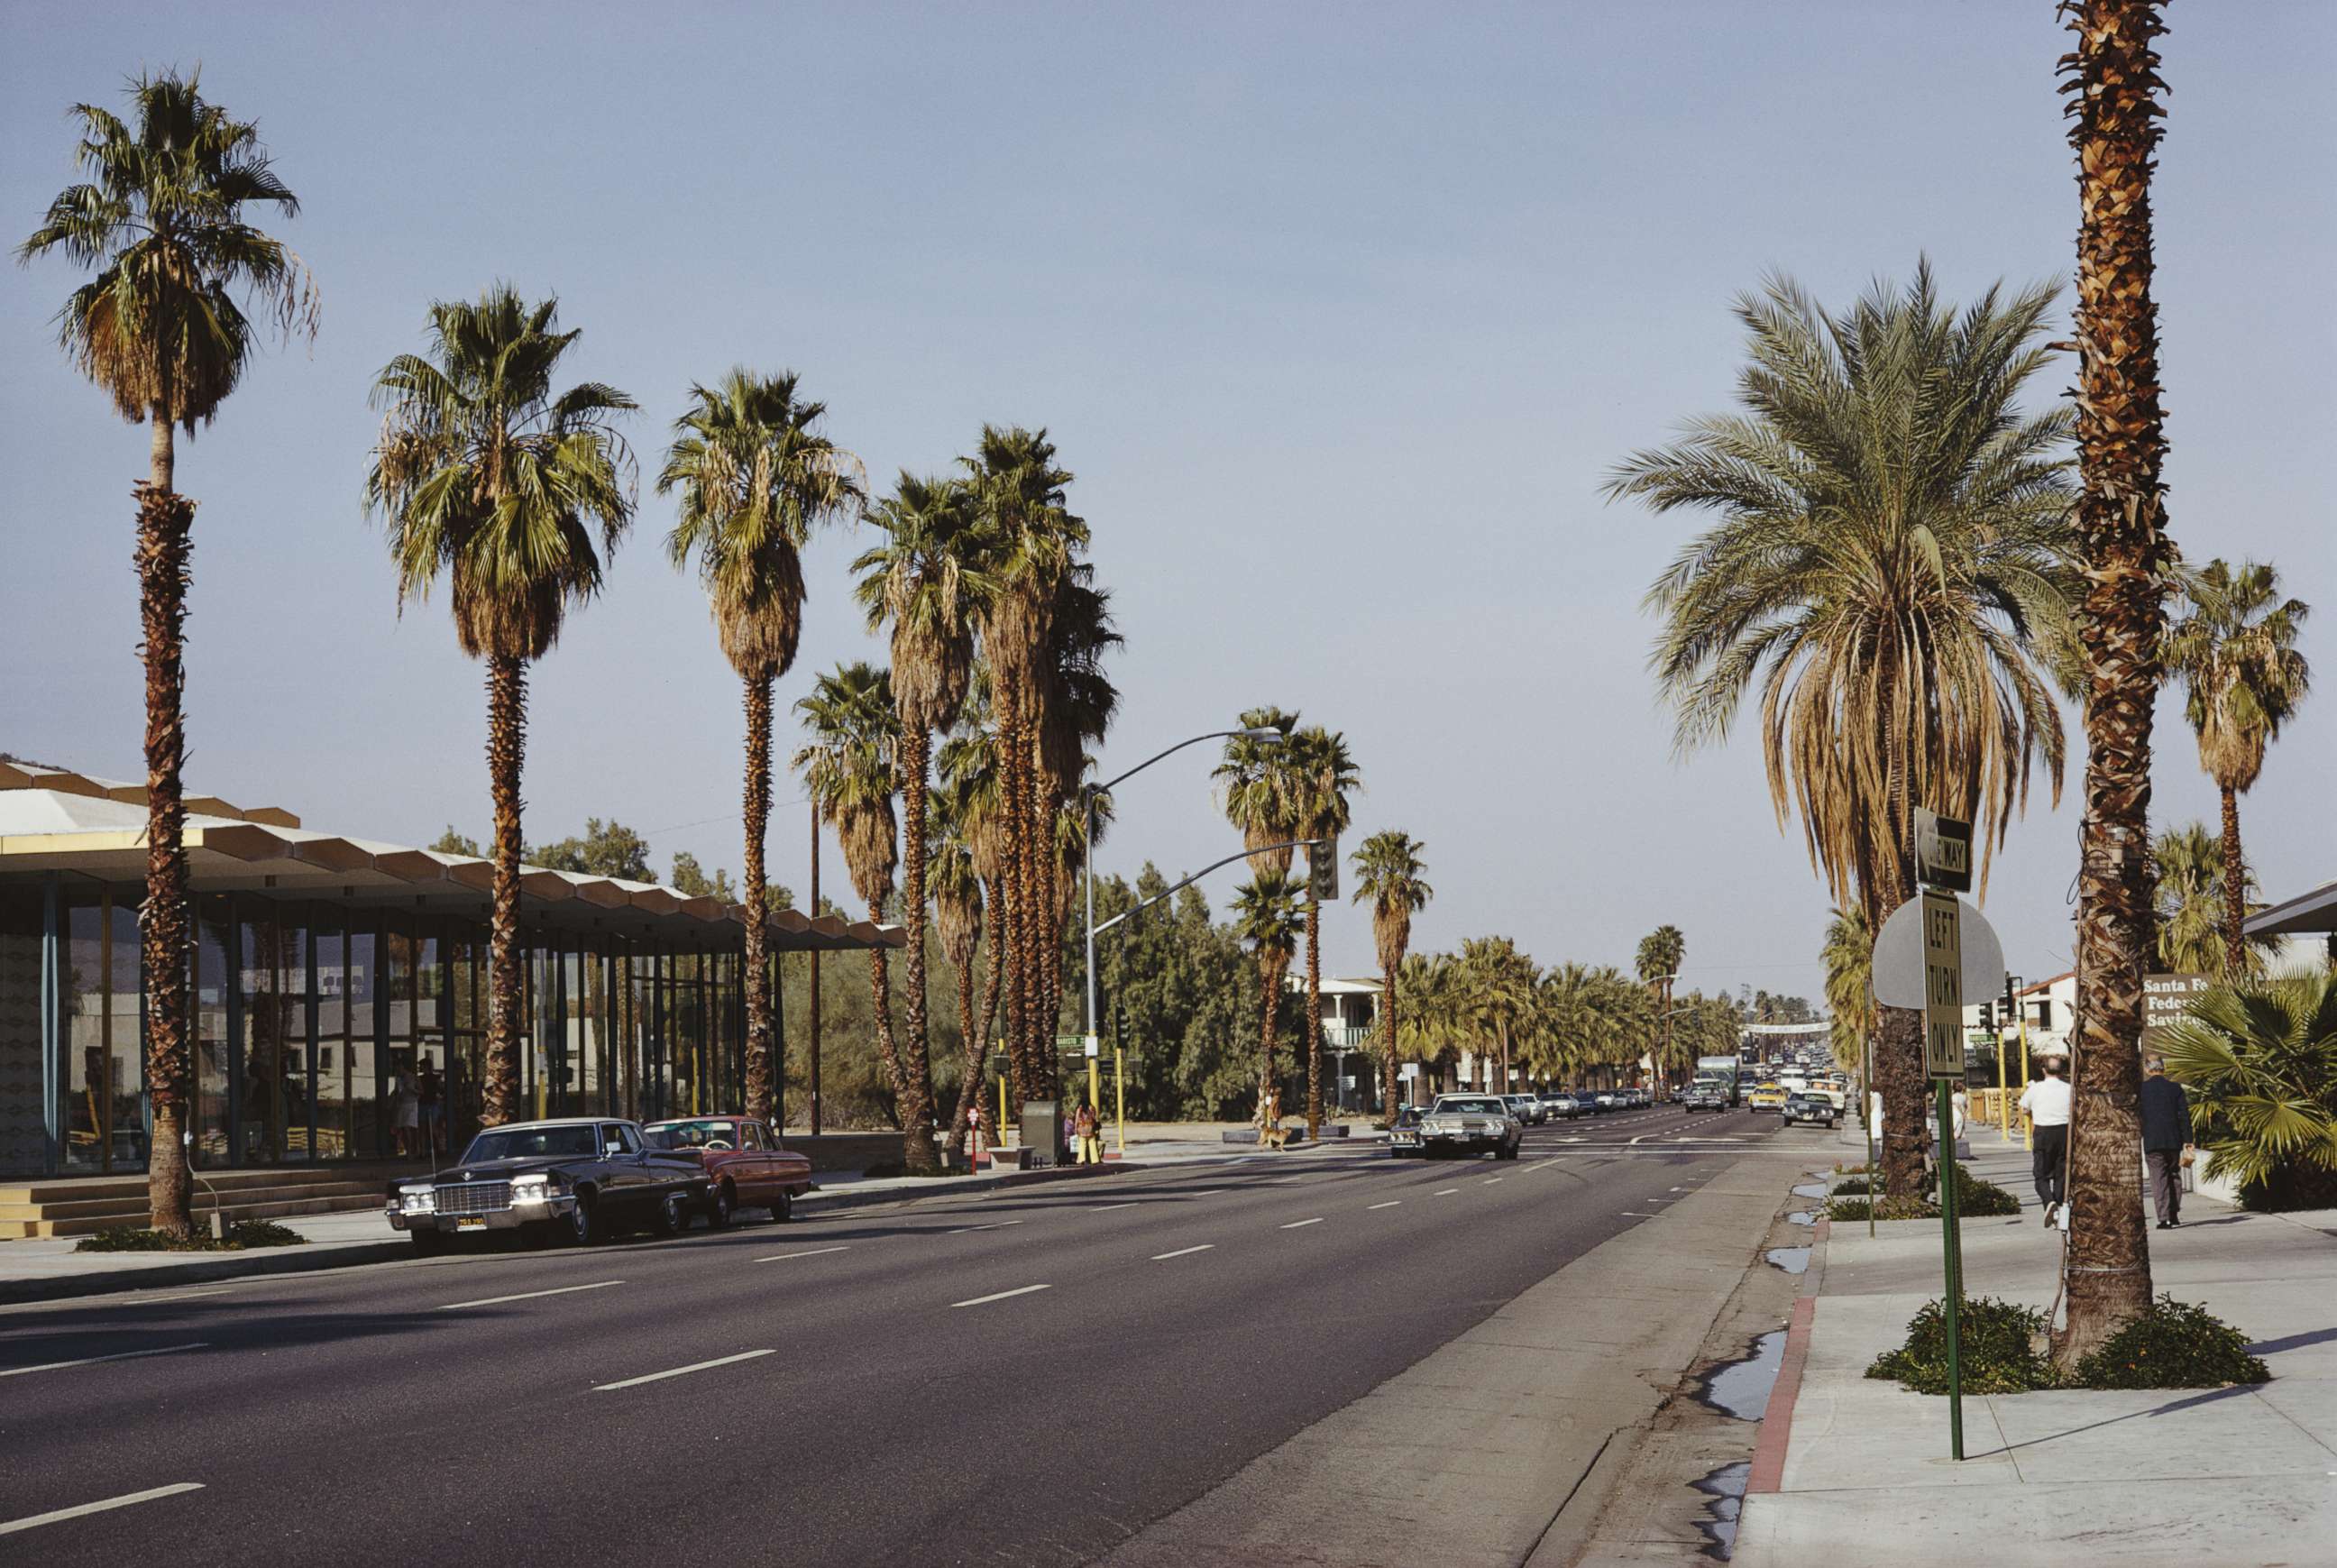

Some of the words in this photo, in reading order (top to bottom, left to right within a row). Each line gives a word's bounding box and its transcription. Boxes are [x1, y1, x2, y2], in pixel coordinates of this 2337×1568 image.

[1929, 837, 1941, 866] OE
[1944, 840, 1964, 868] WAY
[1929, 908, 1955, 952] LEFT
[1929, 965, 1957, 1006] TURN
[2143, 979, 2186, 993] Santa
[2191, 977, 2208, 991] Fe
[2148, 996, 2204, 1010] Fede
[1932, 1022, 1958, 1063] ONLY
